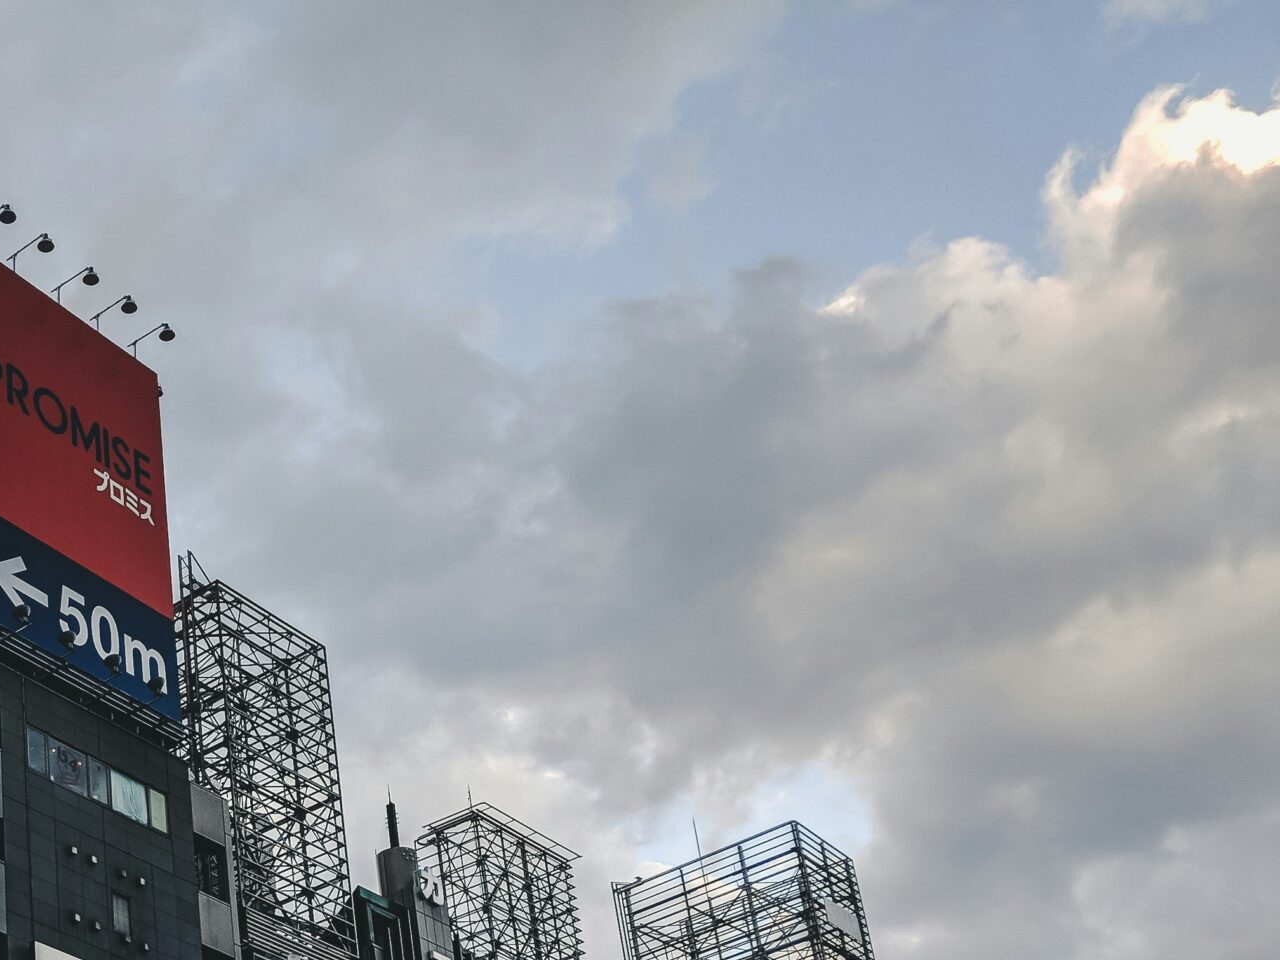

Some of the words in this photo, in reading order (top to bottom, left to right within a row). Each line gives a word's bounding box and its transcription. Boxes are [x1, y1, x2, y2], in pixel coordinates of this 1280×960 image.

[93, 468, 155, 526] プロミス
[60, 585, 167, 695] 50m
